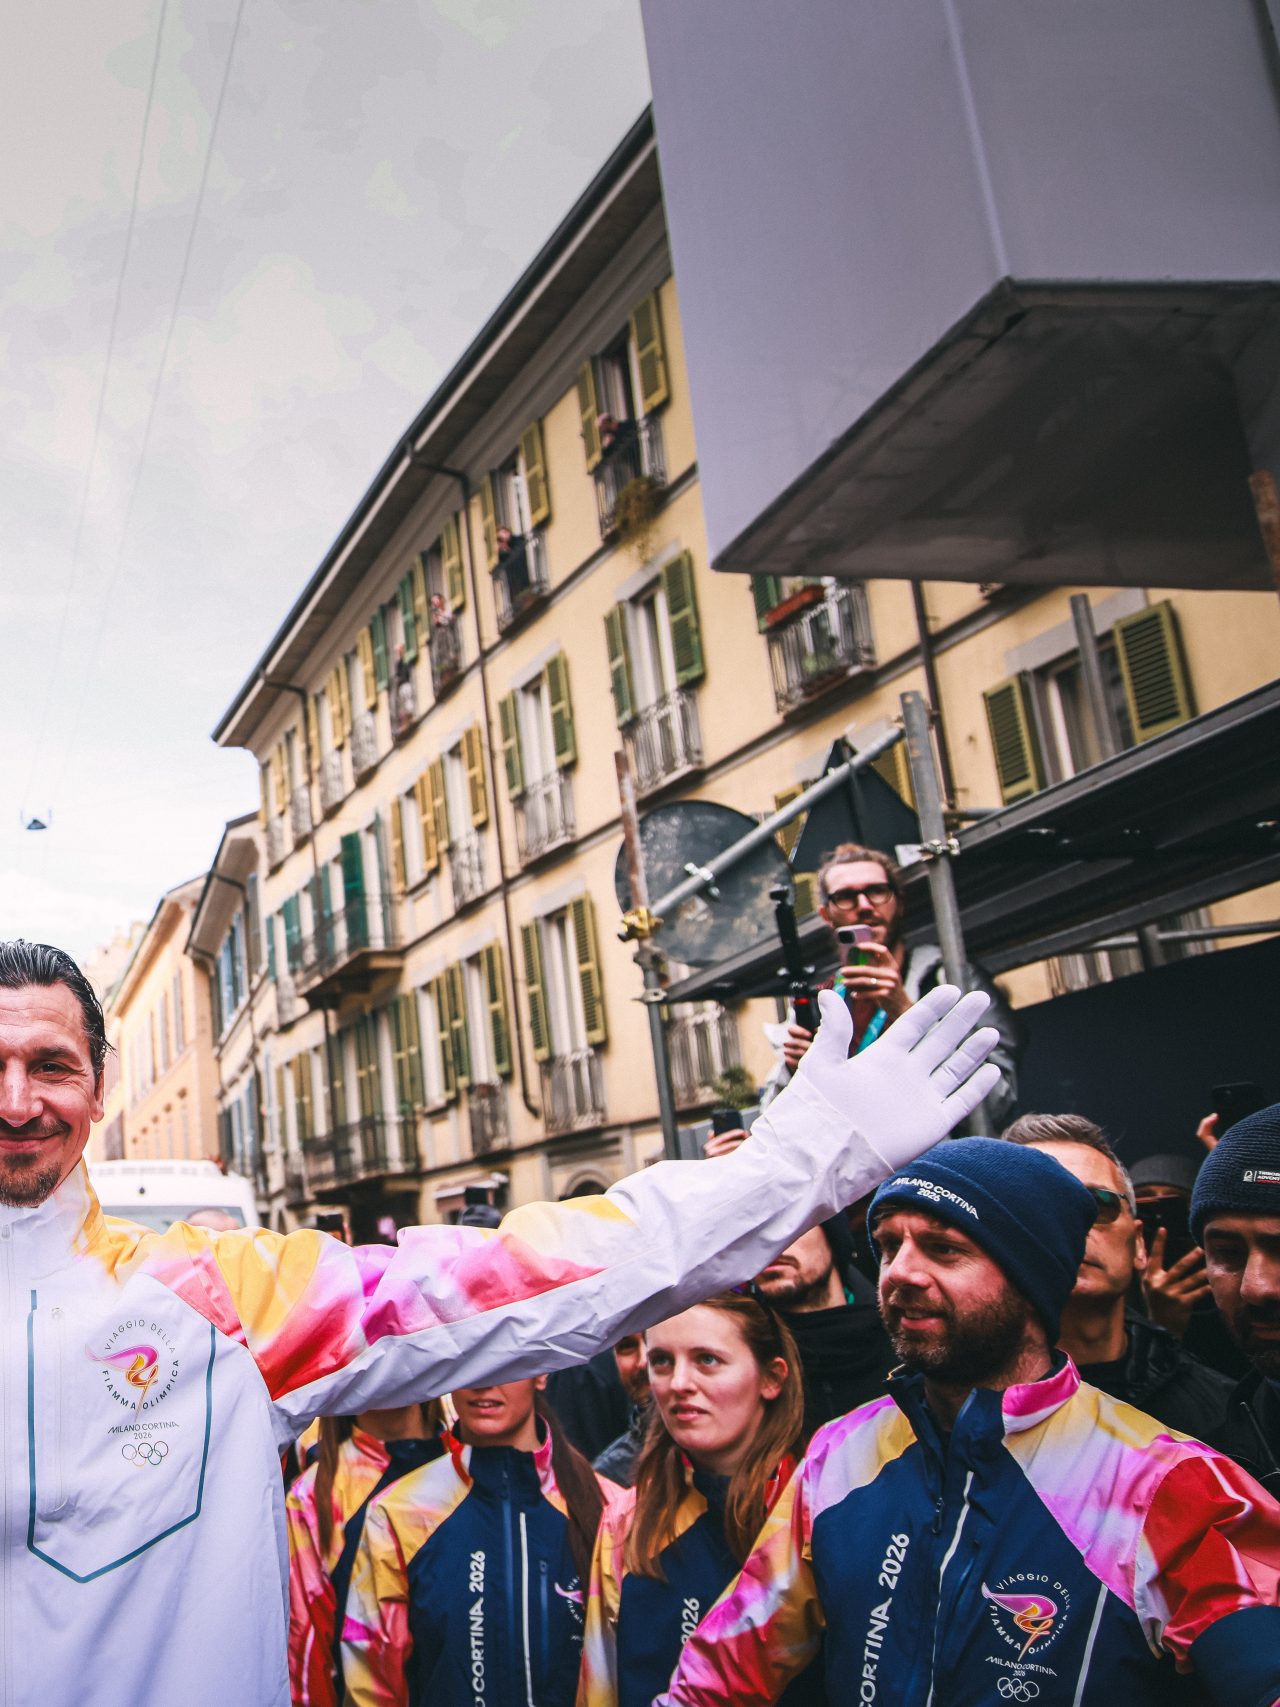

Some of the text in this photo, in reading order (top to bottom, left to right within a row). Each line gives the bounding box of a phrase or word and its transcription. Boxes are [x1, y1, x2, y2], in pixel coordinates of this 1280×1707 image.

[891, 1177, 979, 1220] MILANO CORTINA
[917, 1187, 941, 1202] 2026
[105, 1319, 176, 1353] VIAGGIO DELLA
[102, 1359, 180, 1410] FIAMMA OLIMPICA
[108, 1421, 179, 1434] MILANO CORTINA
[134, 1432, 152, 1440] 2026
[469, 1550, 486, 1593] 2026
[996, 1573, 1049, 1591] VIAGGIO
[859, 1533, 910, 1707] ORTINA 2026
[990, 1605, 1021, 1651] FIAMMA
[469, 1597, 486, 1693] CORTINA
[985, 1656, 1022, 1670] MILANO
